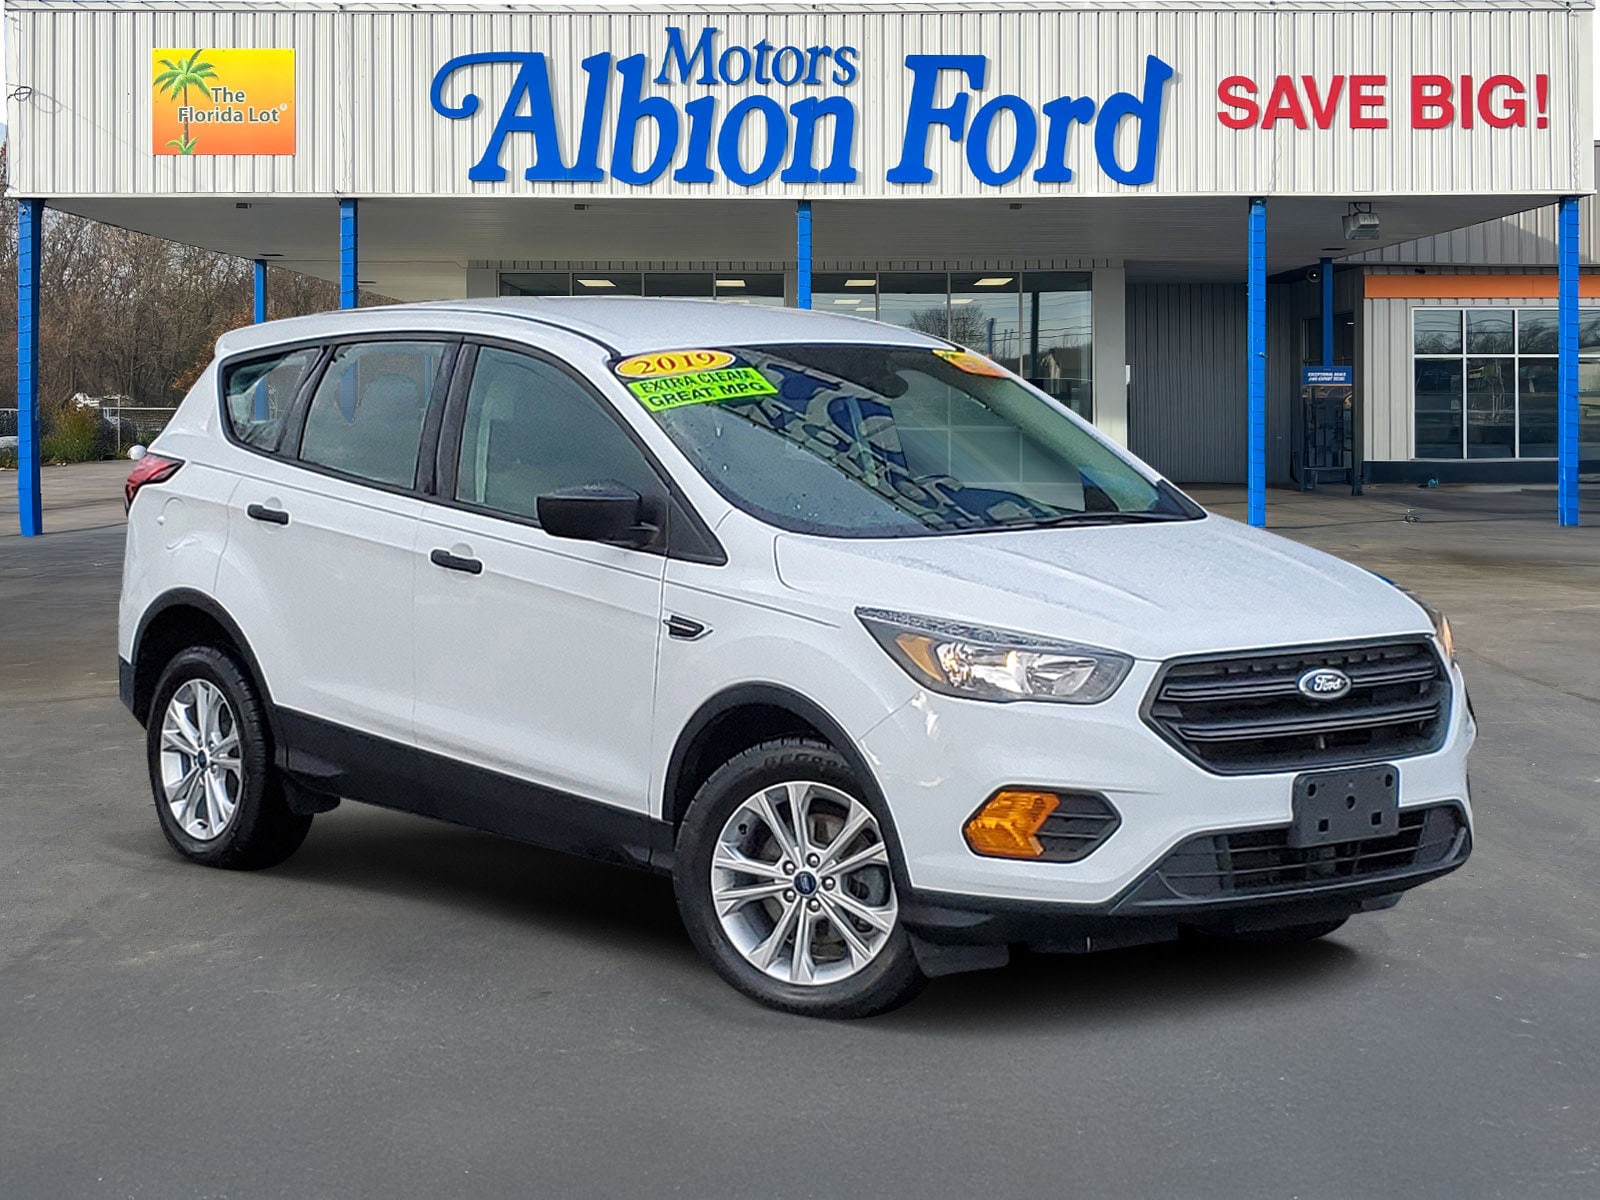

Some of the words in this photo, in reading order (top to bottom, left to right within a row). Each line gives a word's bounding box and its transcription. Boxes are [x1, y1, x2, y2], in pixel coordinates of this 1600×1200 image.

[653, 27, 857, 86] Motors
[211, 87, 246, 103] The
[1217, 74, 1389, 130] SAVE
[1410, 74, 1548, 130] BIG!
[178, 106, 244, 122] Florida
[430, 52, 858, 186] Albion
[886, 54, 1174, 186] Ford
[634, 352, 716, 374] 2019
[639, 375, 695, 393] EXTRA
[698, 368, 754, 384] CLEAN
[648, 387, 714, 407] GREAT
[720, 382, 765, 395] MPG
[1313, 674, 1343, 692] Ford
